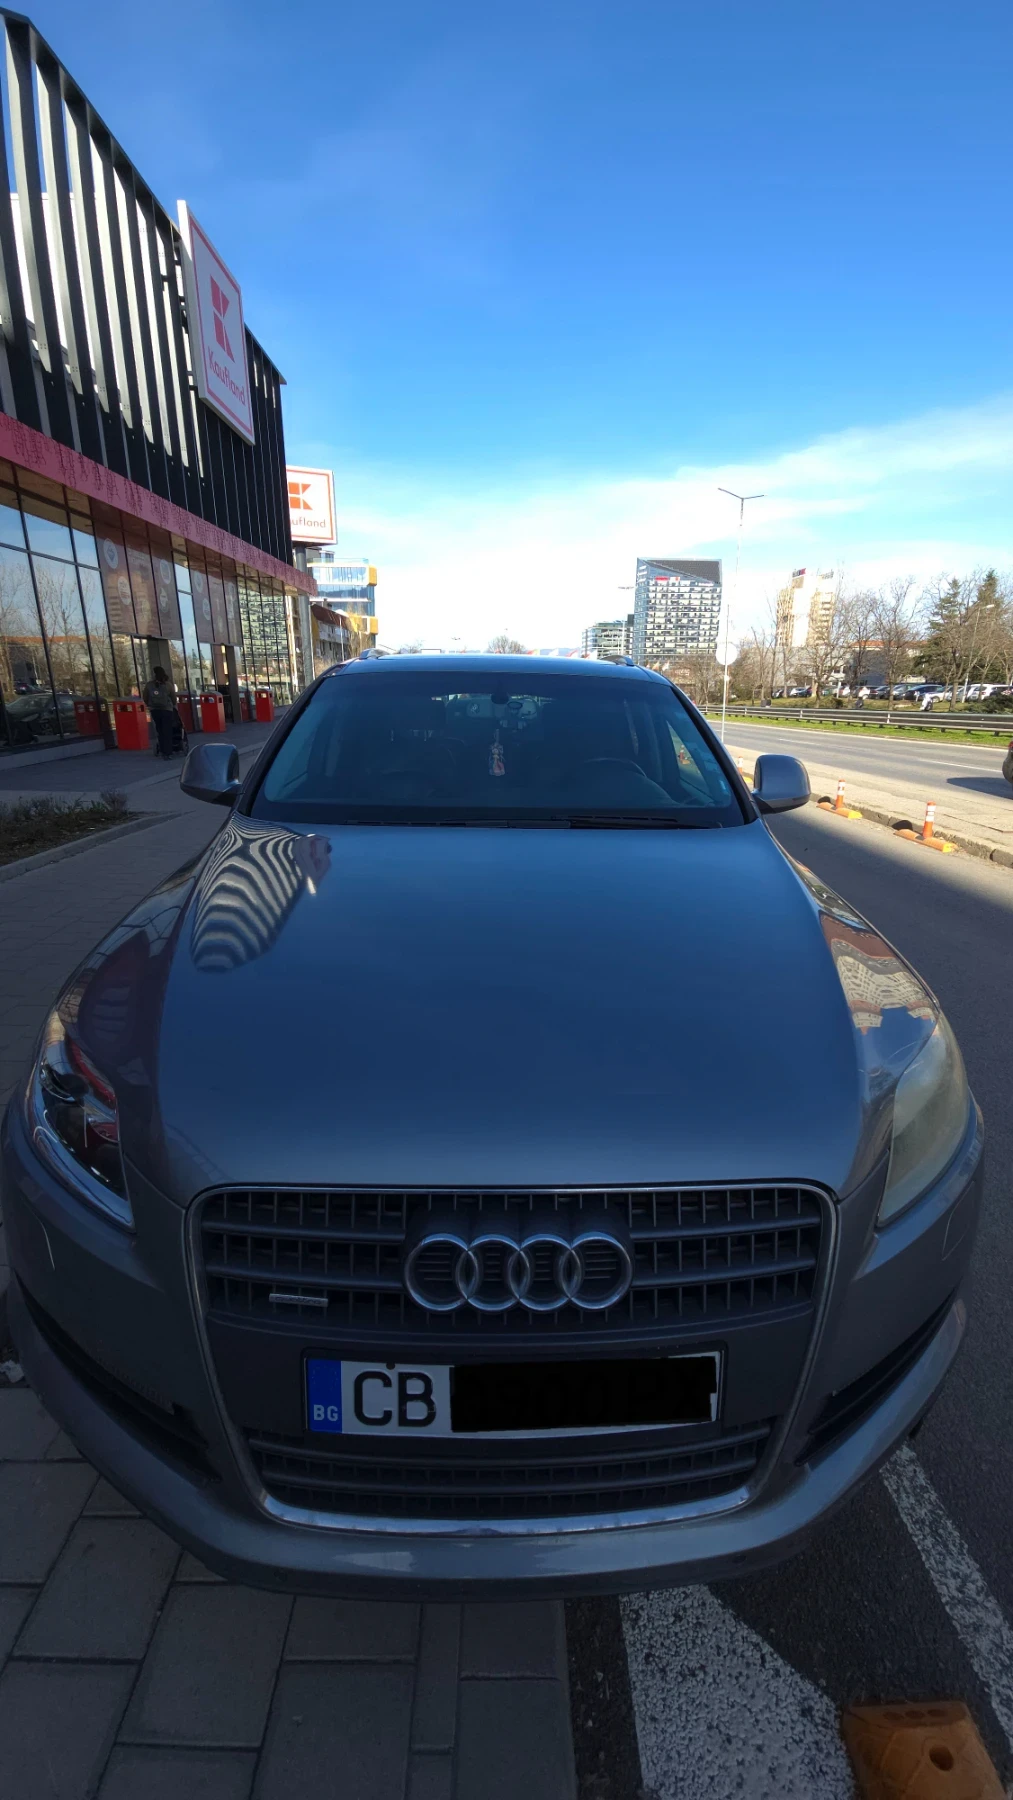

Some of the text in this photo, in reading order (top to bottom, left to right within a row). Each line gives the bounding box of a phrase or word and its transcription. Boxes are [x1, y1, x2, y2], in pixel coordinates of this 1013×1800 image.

[208, 346, 246, 406] Kaufland
[291, 516, 326, 528] ufland
[313, 1404, 339, 1422] BG
[354, 1370, 437, 1428] CB
